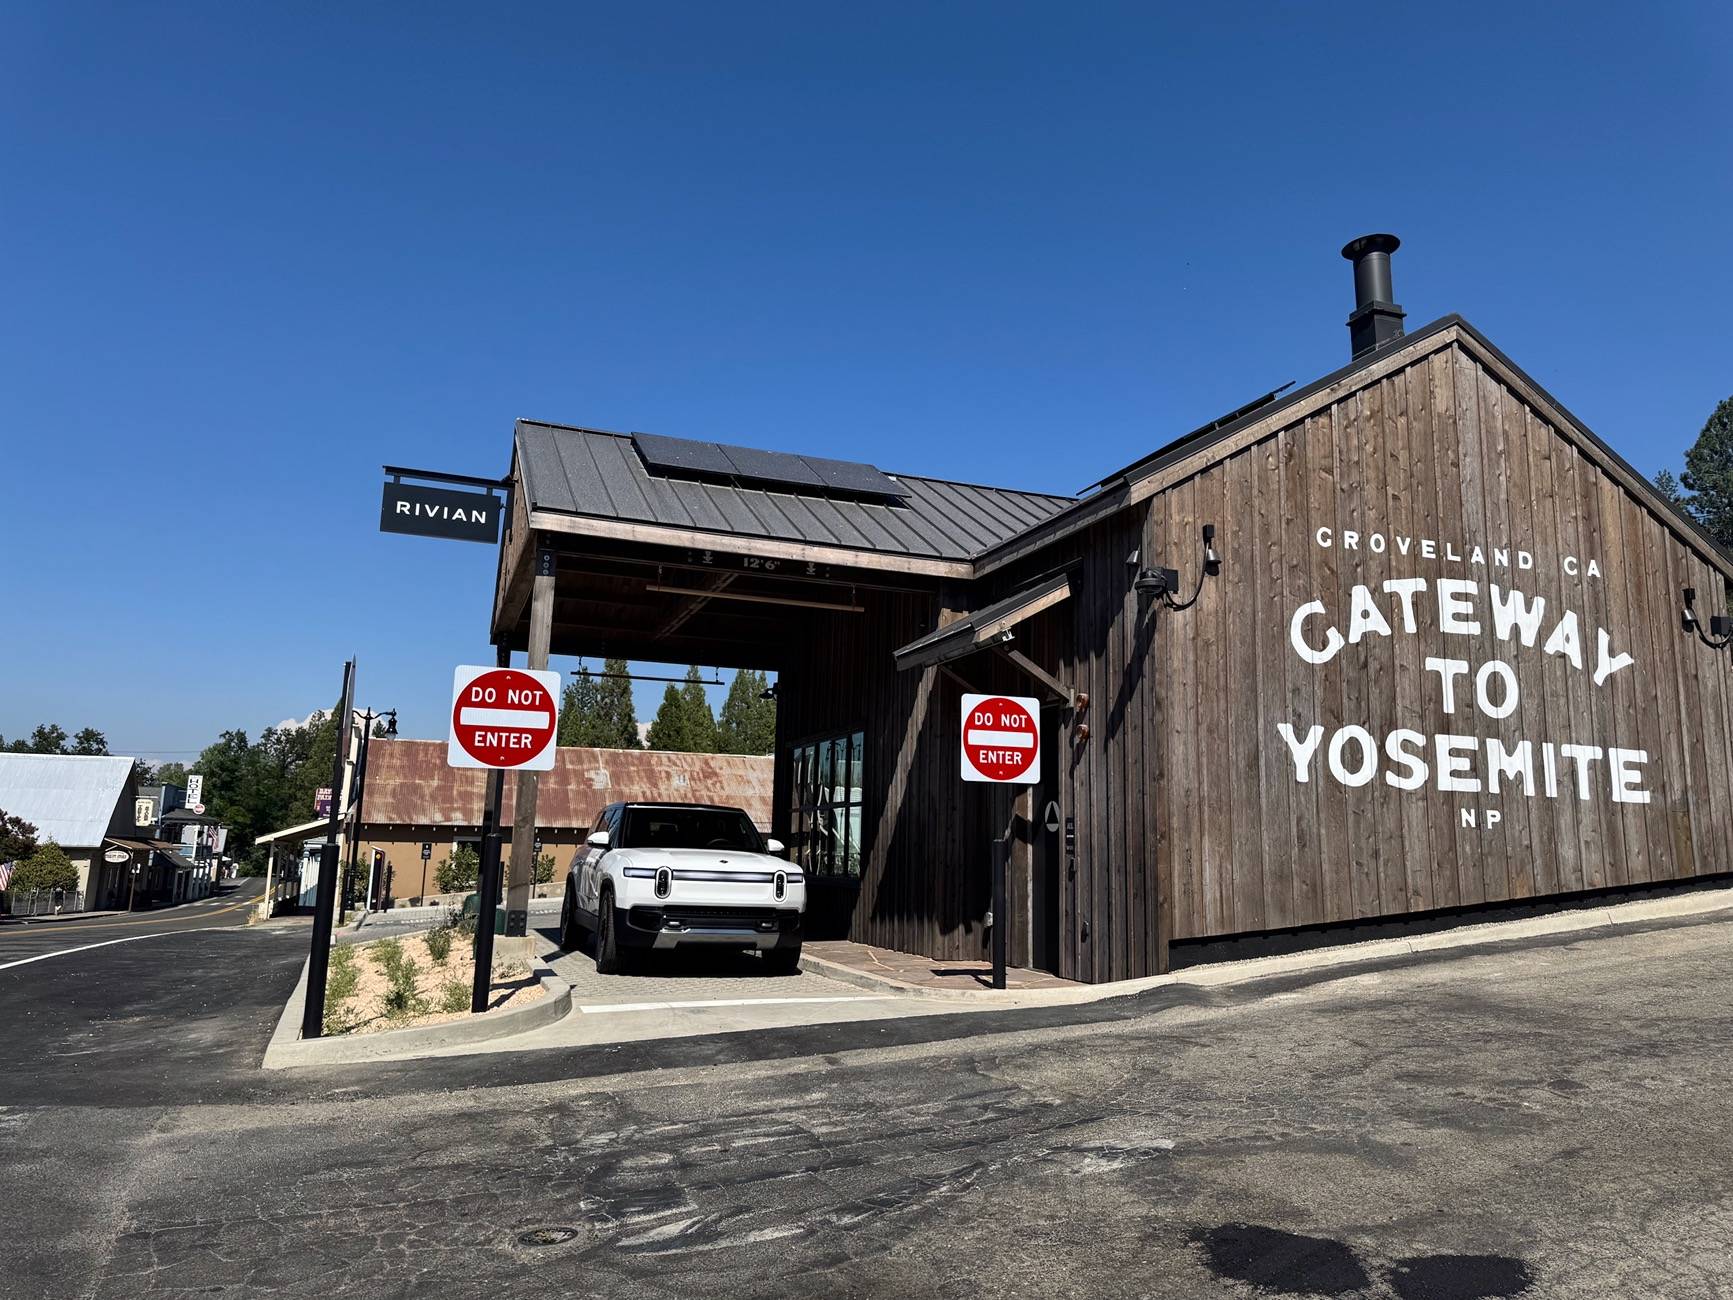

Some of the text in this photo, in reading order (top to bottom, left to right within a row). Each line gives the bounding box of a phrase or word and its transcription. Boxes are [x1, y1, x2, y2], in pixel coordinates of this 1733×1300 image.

[396, 500, 487, 524] RIVIAN
[1316, 526, 1602, 578] GROVELAND CA
[1290, 577, 1635, 687] GATEWAY
[471, 686, 544, 706] DO NOT
[1424, 656, 1519, 719] TO
[974, 712, 1029, 728] DO NOT
[474, 731, 534, 750] ENTER
[979, 749, 1022, 765] ENTER
[1276, 722, 1651, 804] YOSEMITE
[187, 778, 199, 804] HOTEL
[1460, 807, 1502, 830] NP
